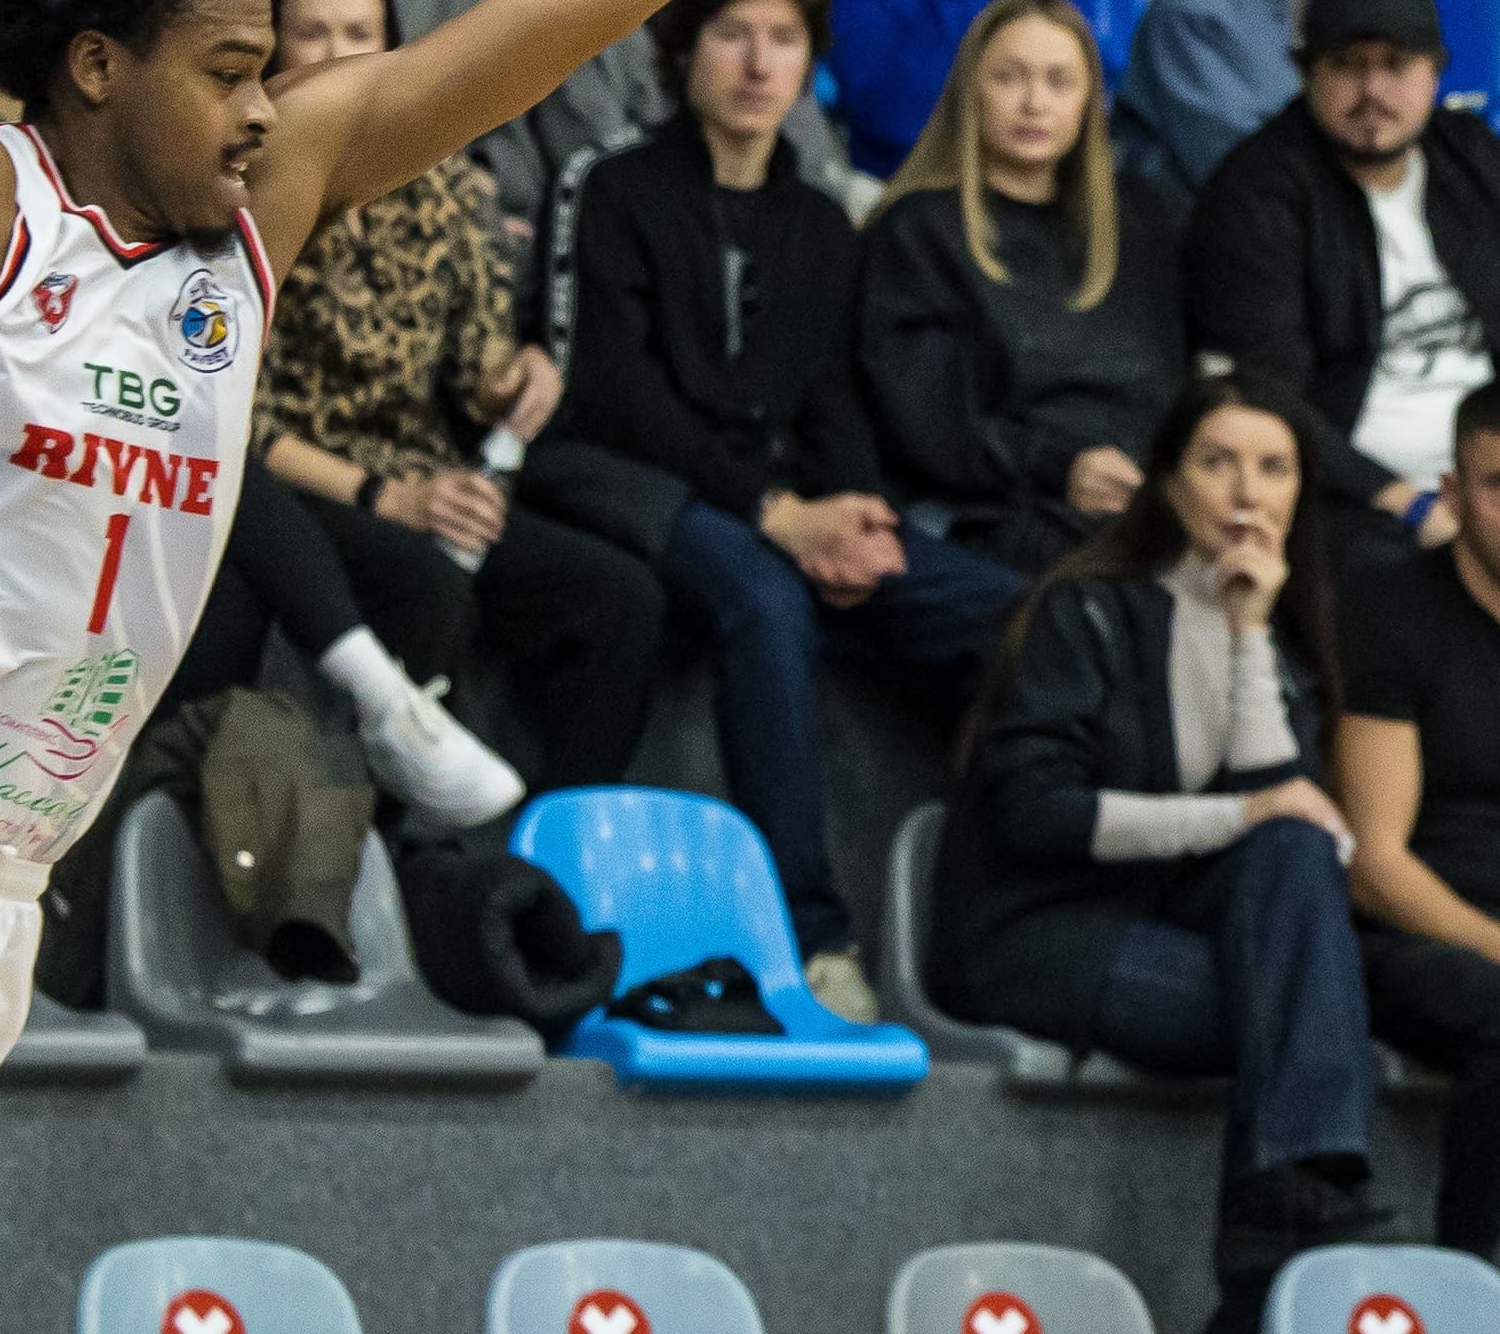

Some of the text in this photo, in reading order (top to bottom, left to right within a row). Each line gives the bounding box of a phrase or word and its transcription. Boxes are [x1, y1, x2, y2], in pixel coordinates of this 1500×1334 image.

[83, 362, 181, 417] TBG
[10, 423, 220, 516] RIVNE
[86, 512, 131, 635] 1
